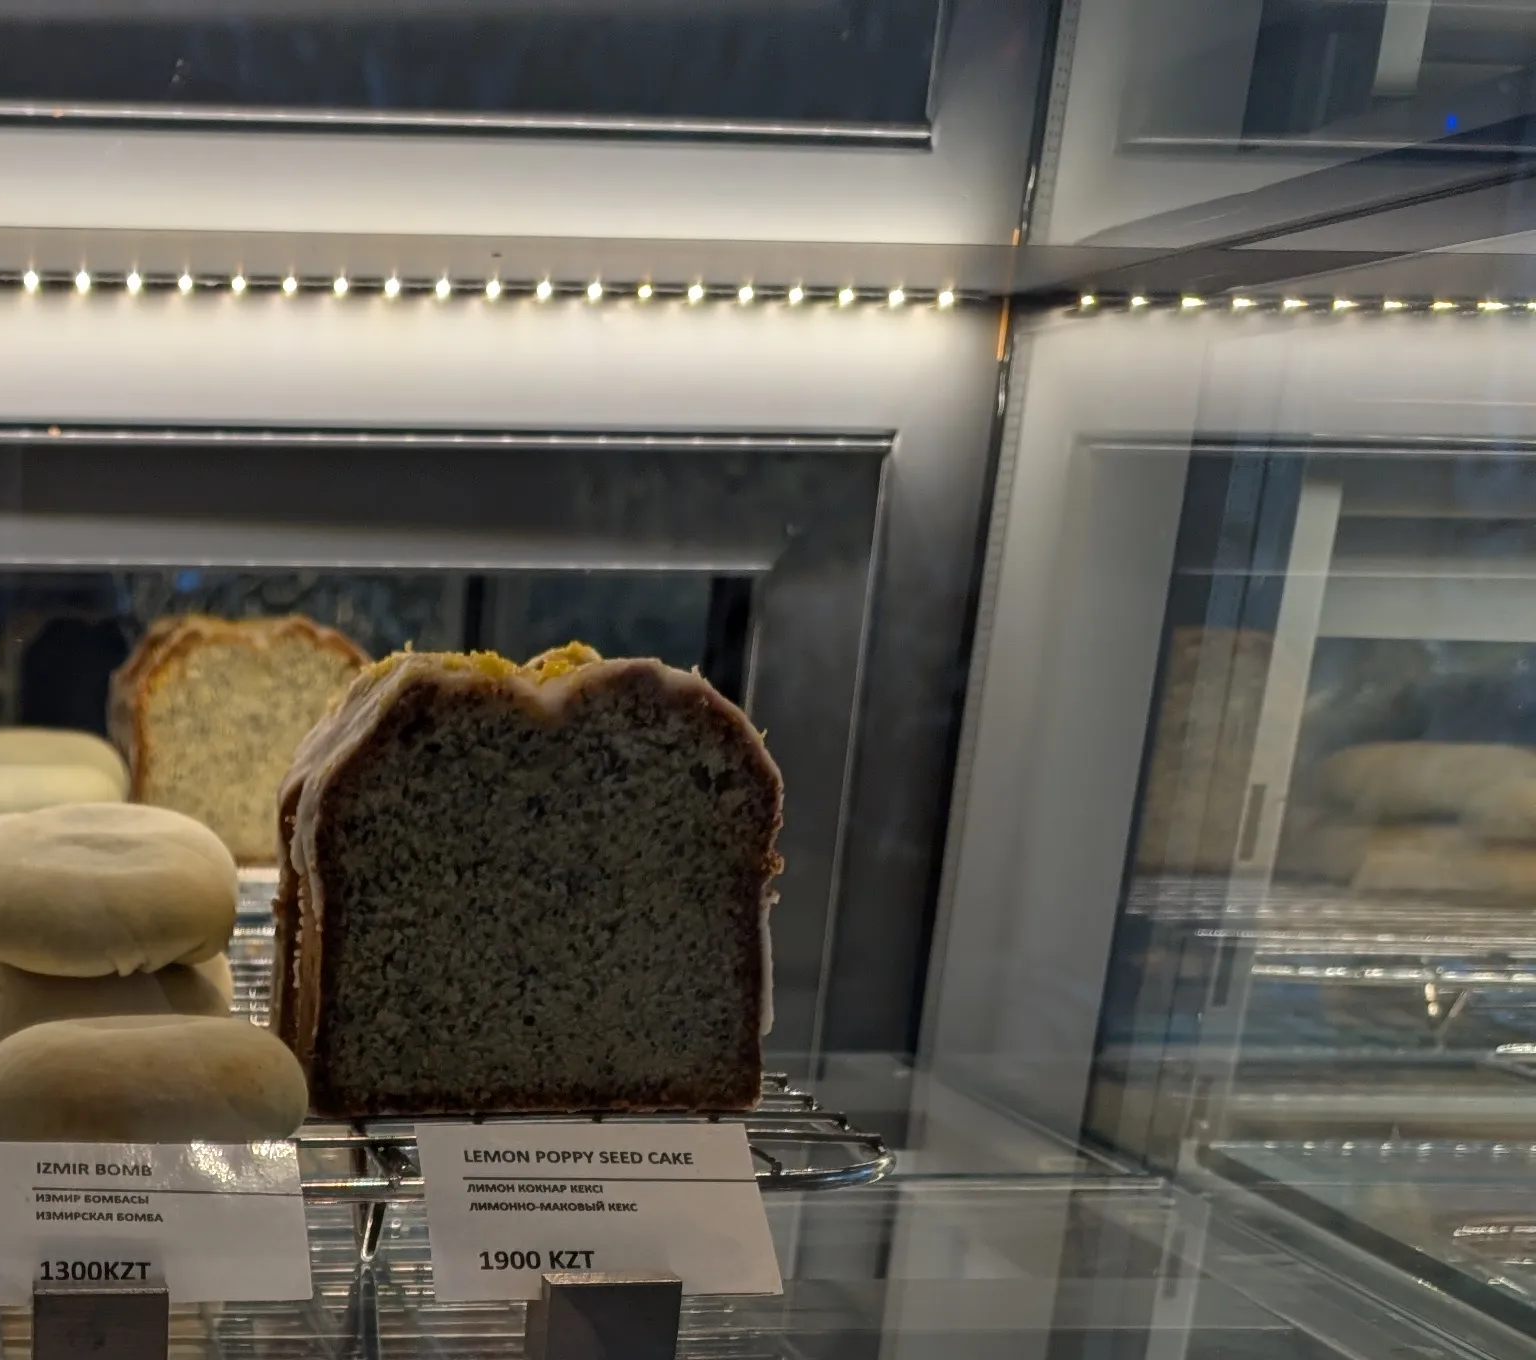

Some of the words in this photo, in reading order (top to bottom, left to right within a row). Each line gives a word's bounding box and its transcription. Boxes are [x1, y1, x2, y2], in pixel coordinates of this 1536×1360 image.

[464, 1150, 530, 1164] LEMON
[536, 1150, 594, 1165] POPPY
[599, 1151, 643, 1165] SEED
[648, 1151, 694, 1165] CAKE
[36, 1162, 89, 1176] IZMIR
[96, 1163, 153, 1177] BOMB
[467, 1184, 515, 1193] ЛИМОН
[518, 1184, 567, 1194] КОКНАР
[36, 1193, 81, 1203] ИЗМИР
[84, 1195, 149, 1204] БОМБАСЫ
[470, 1200, 605, 1212] ЛИМОННО-МАКОВЫЙ
[608, 1202, 638, 1212] КЕКС
[36, 1211, 113, 1222] ИЗМИРСКАЯ
[116, 1212, 164, 1223] БОМБА
[479, 1251, 542, 1271] 1900
[549, 1250, 595, 1269] KZT
[40, 1261, 151, 1281] 1300KZT
